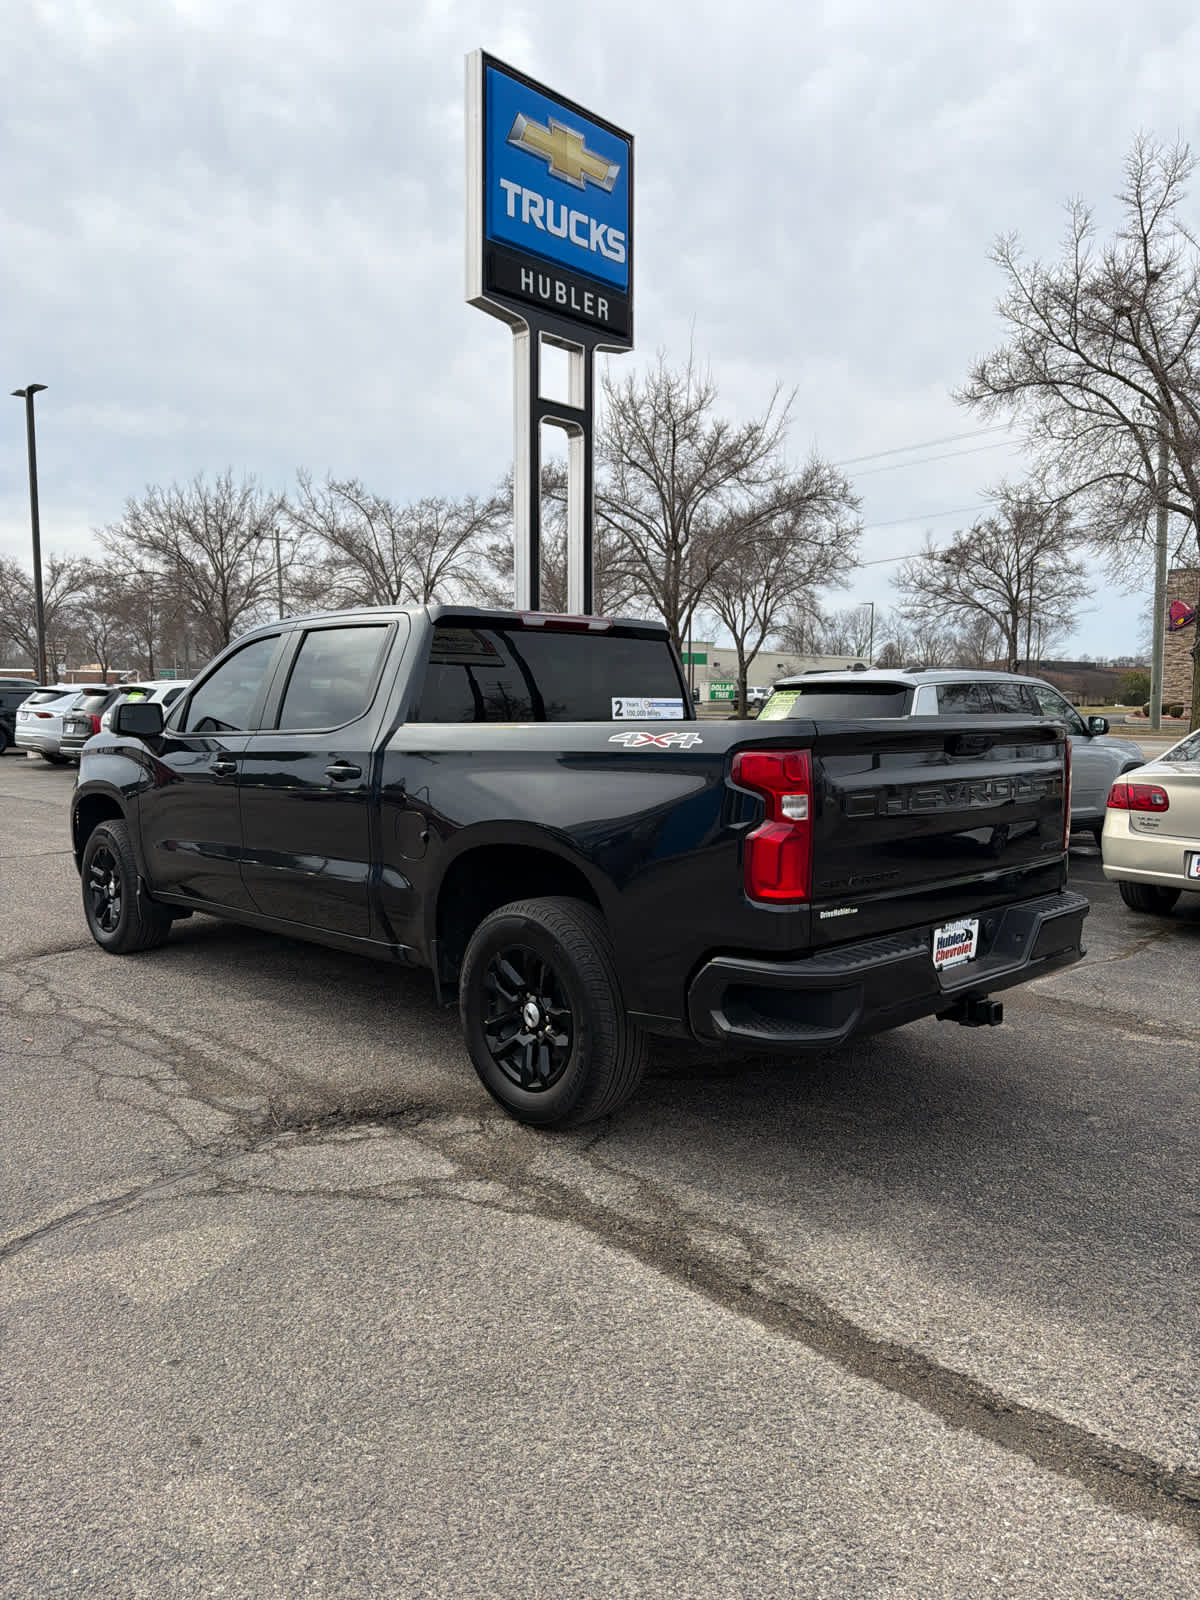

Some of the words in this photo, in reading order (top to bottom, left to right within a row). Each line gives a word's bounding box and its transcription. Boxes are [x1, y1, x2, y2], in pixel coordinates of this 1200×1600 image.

[499, 178, 626, 264] TRUCKS
[520, 267, 609, 321] HUBLER
[715, 691, 730, 699] TREE
[614, 700, 624, 717] 2
[936, 932, 966, 951] Hubler
[935, 941, 973, 963] Chevrolet
